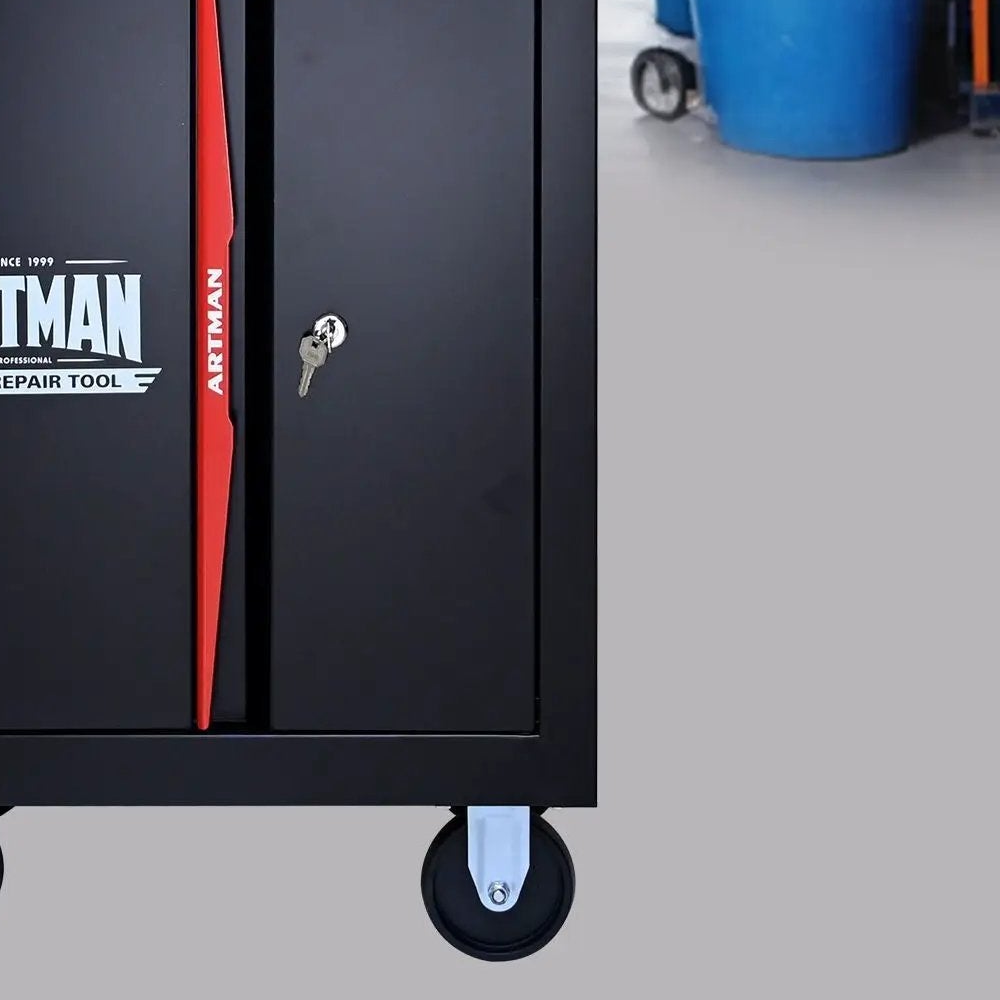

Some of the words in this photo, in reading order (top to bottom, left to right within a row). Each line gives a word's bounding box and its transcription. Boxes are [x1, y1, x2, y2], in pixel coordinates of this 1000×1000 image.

[27, 256, 55, 268] 1999
[206, 268, 224, 396] ARTMAN
[68, 373, 122, 389] TOOL
